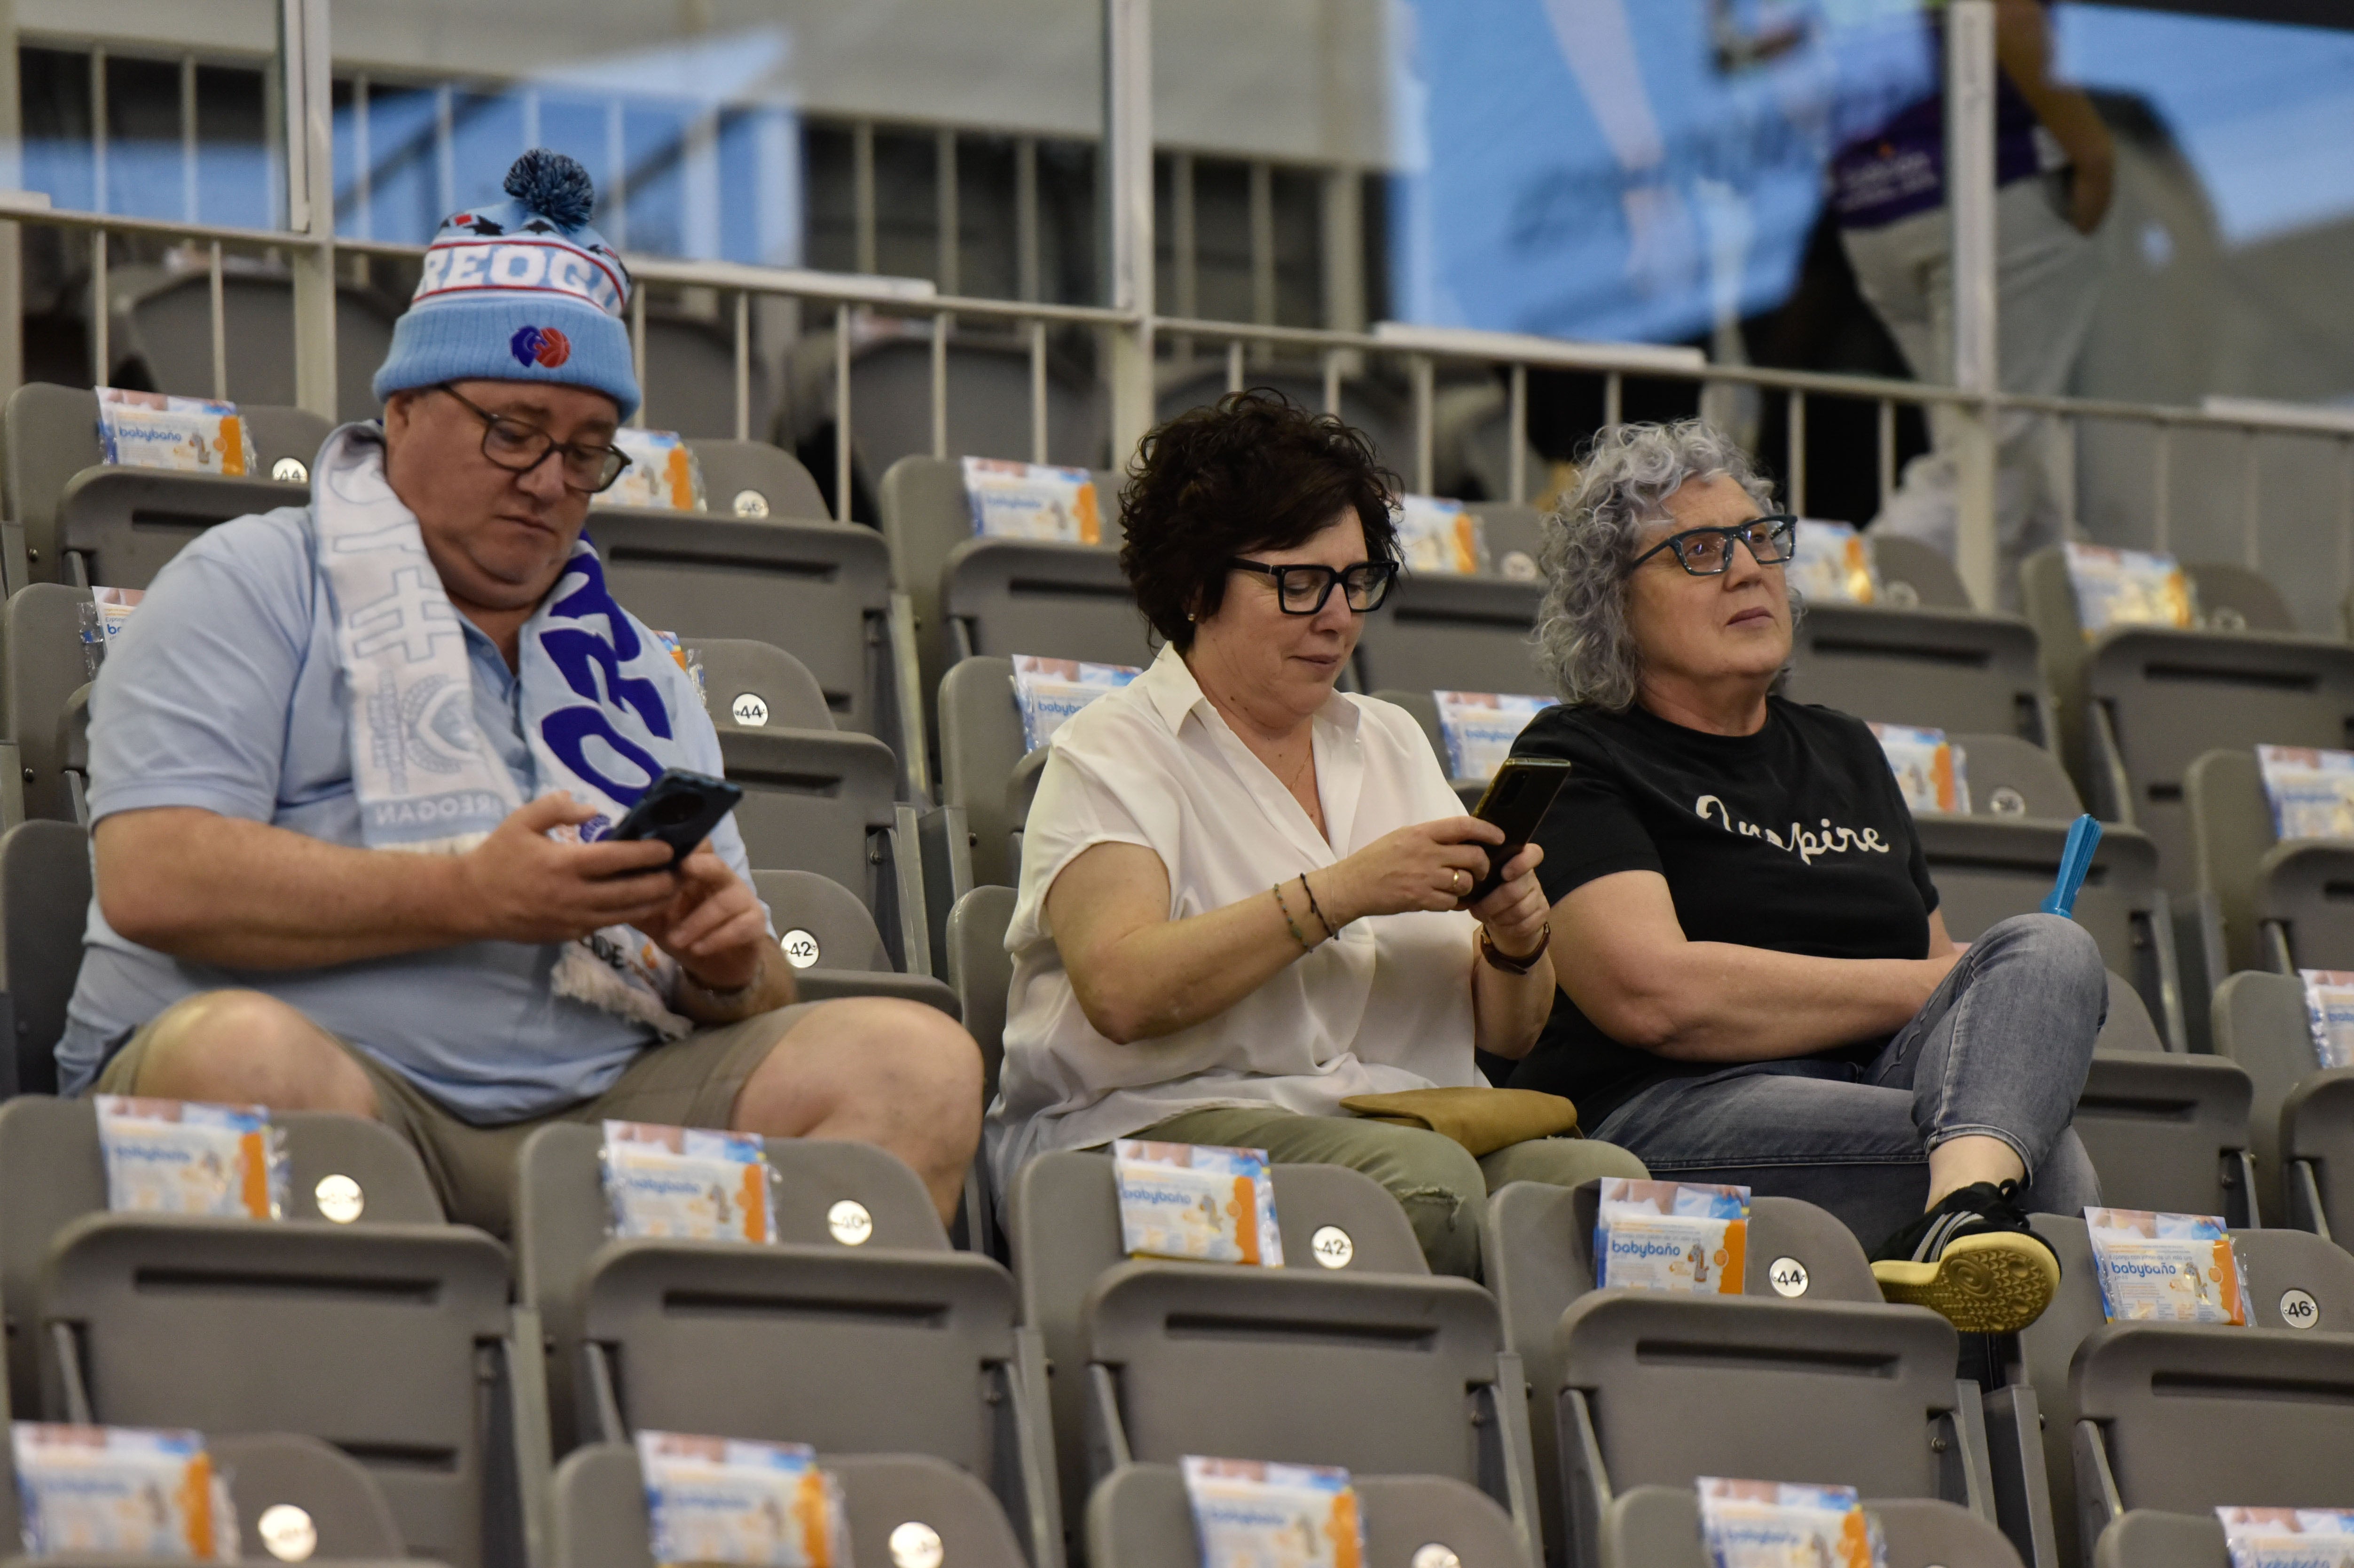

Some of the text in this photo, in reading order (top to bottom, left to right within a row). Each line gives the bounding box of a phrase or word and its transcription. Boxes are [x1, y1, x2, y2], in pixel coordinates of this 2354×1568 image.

[119, 427, 181, 442] babybaño
[279, 468, 300, 480] 44
[740, 705, 762, 719] 44
[790, 942, 813, 957] 42
[1122, 1186, 1191, 1204] babybaño
[1322, 1240, 1346, 1255] 42
[1612, 1239, 1681, 1258] babybaño
[2111, 1261, 2176, 1278] babybaño
[1778, 1270, 1802, 1286] 44
[2289, 1301, 2311, 1317] 46
